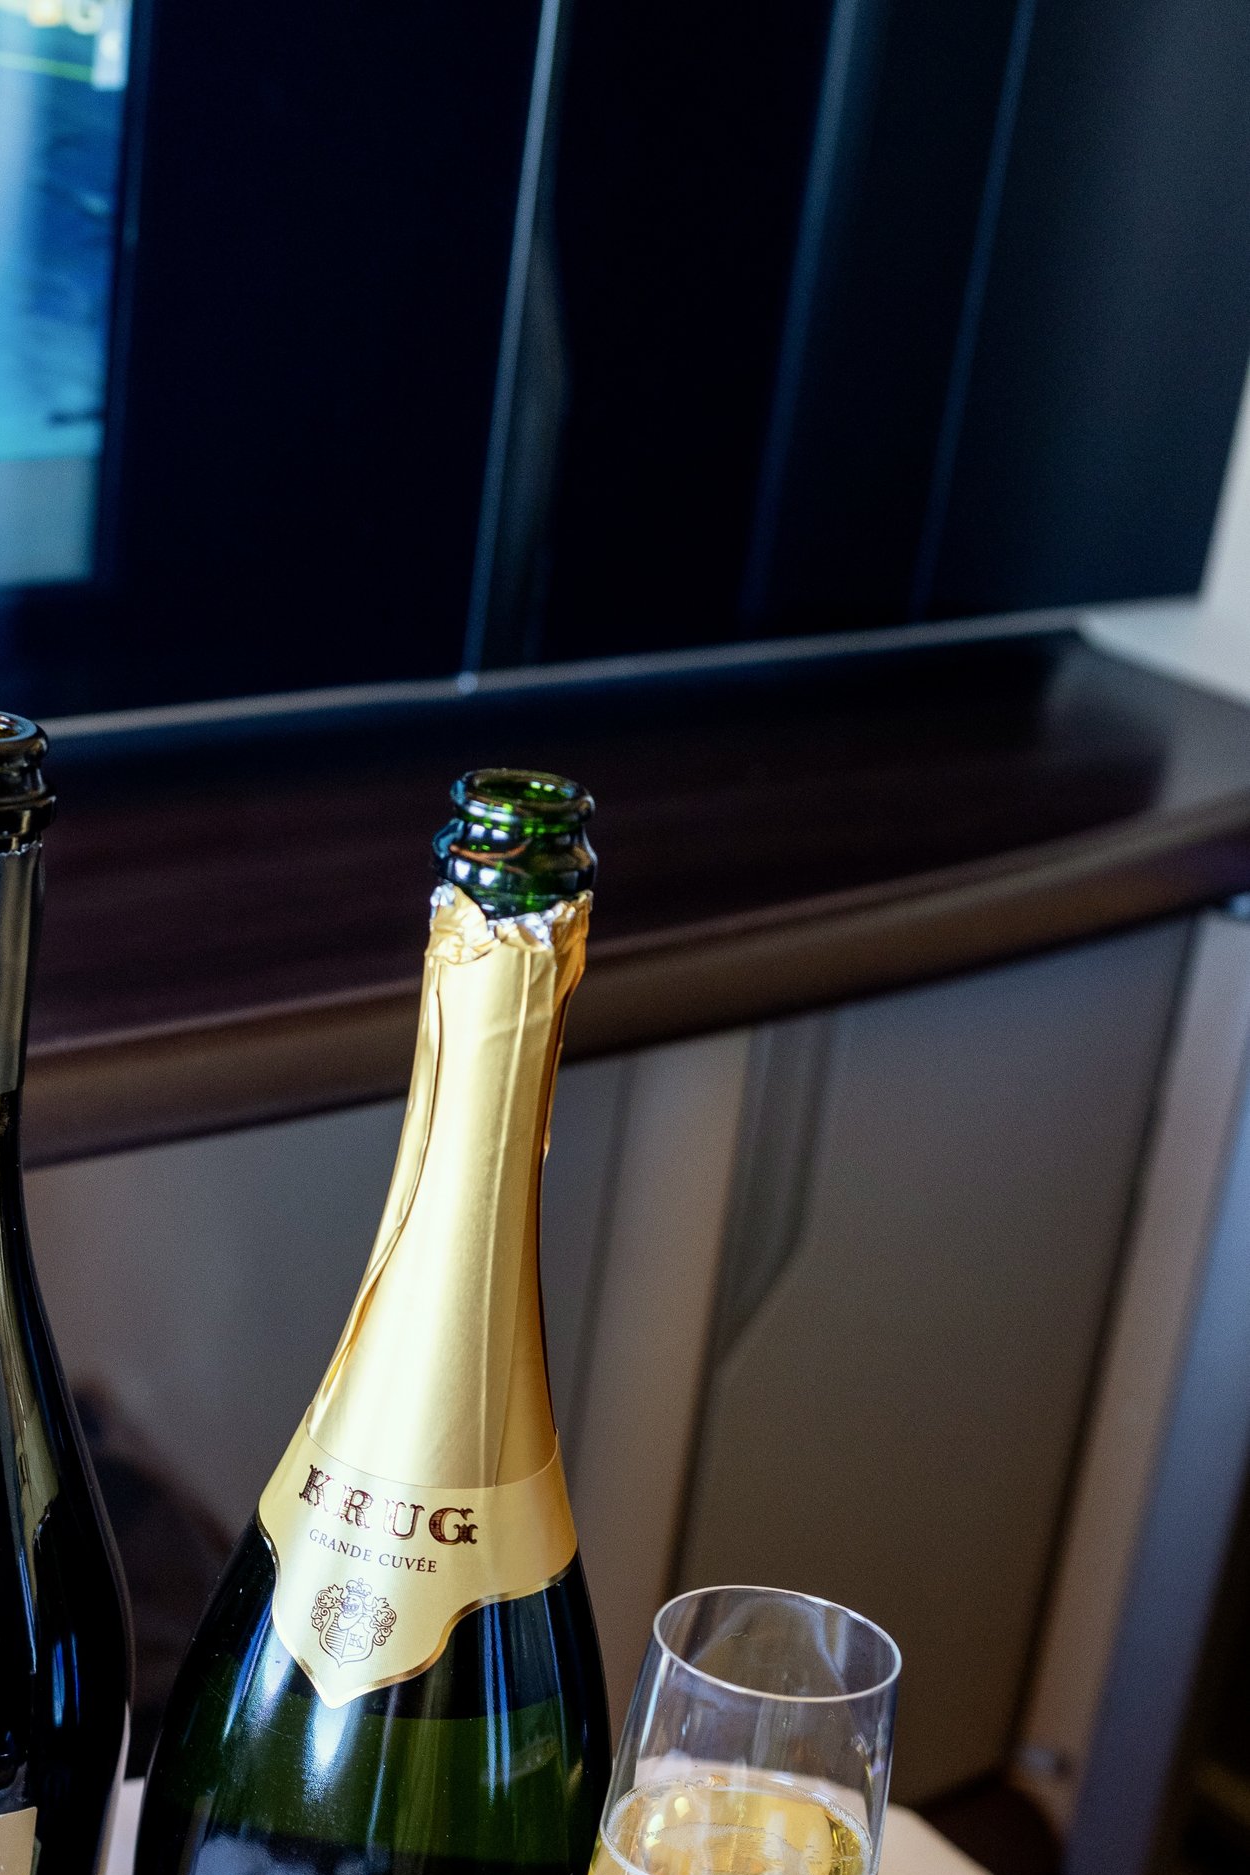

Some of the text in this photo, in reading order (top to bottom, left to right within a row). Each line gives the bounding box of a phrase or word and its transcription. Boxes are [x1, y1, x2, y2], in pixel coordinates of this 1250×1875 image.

[298, 1464, 479, 1546] KRUG
[309, 1528, 438, 1574] GRANDE CUVÉE
